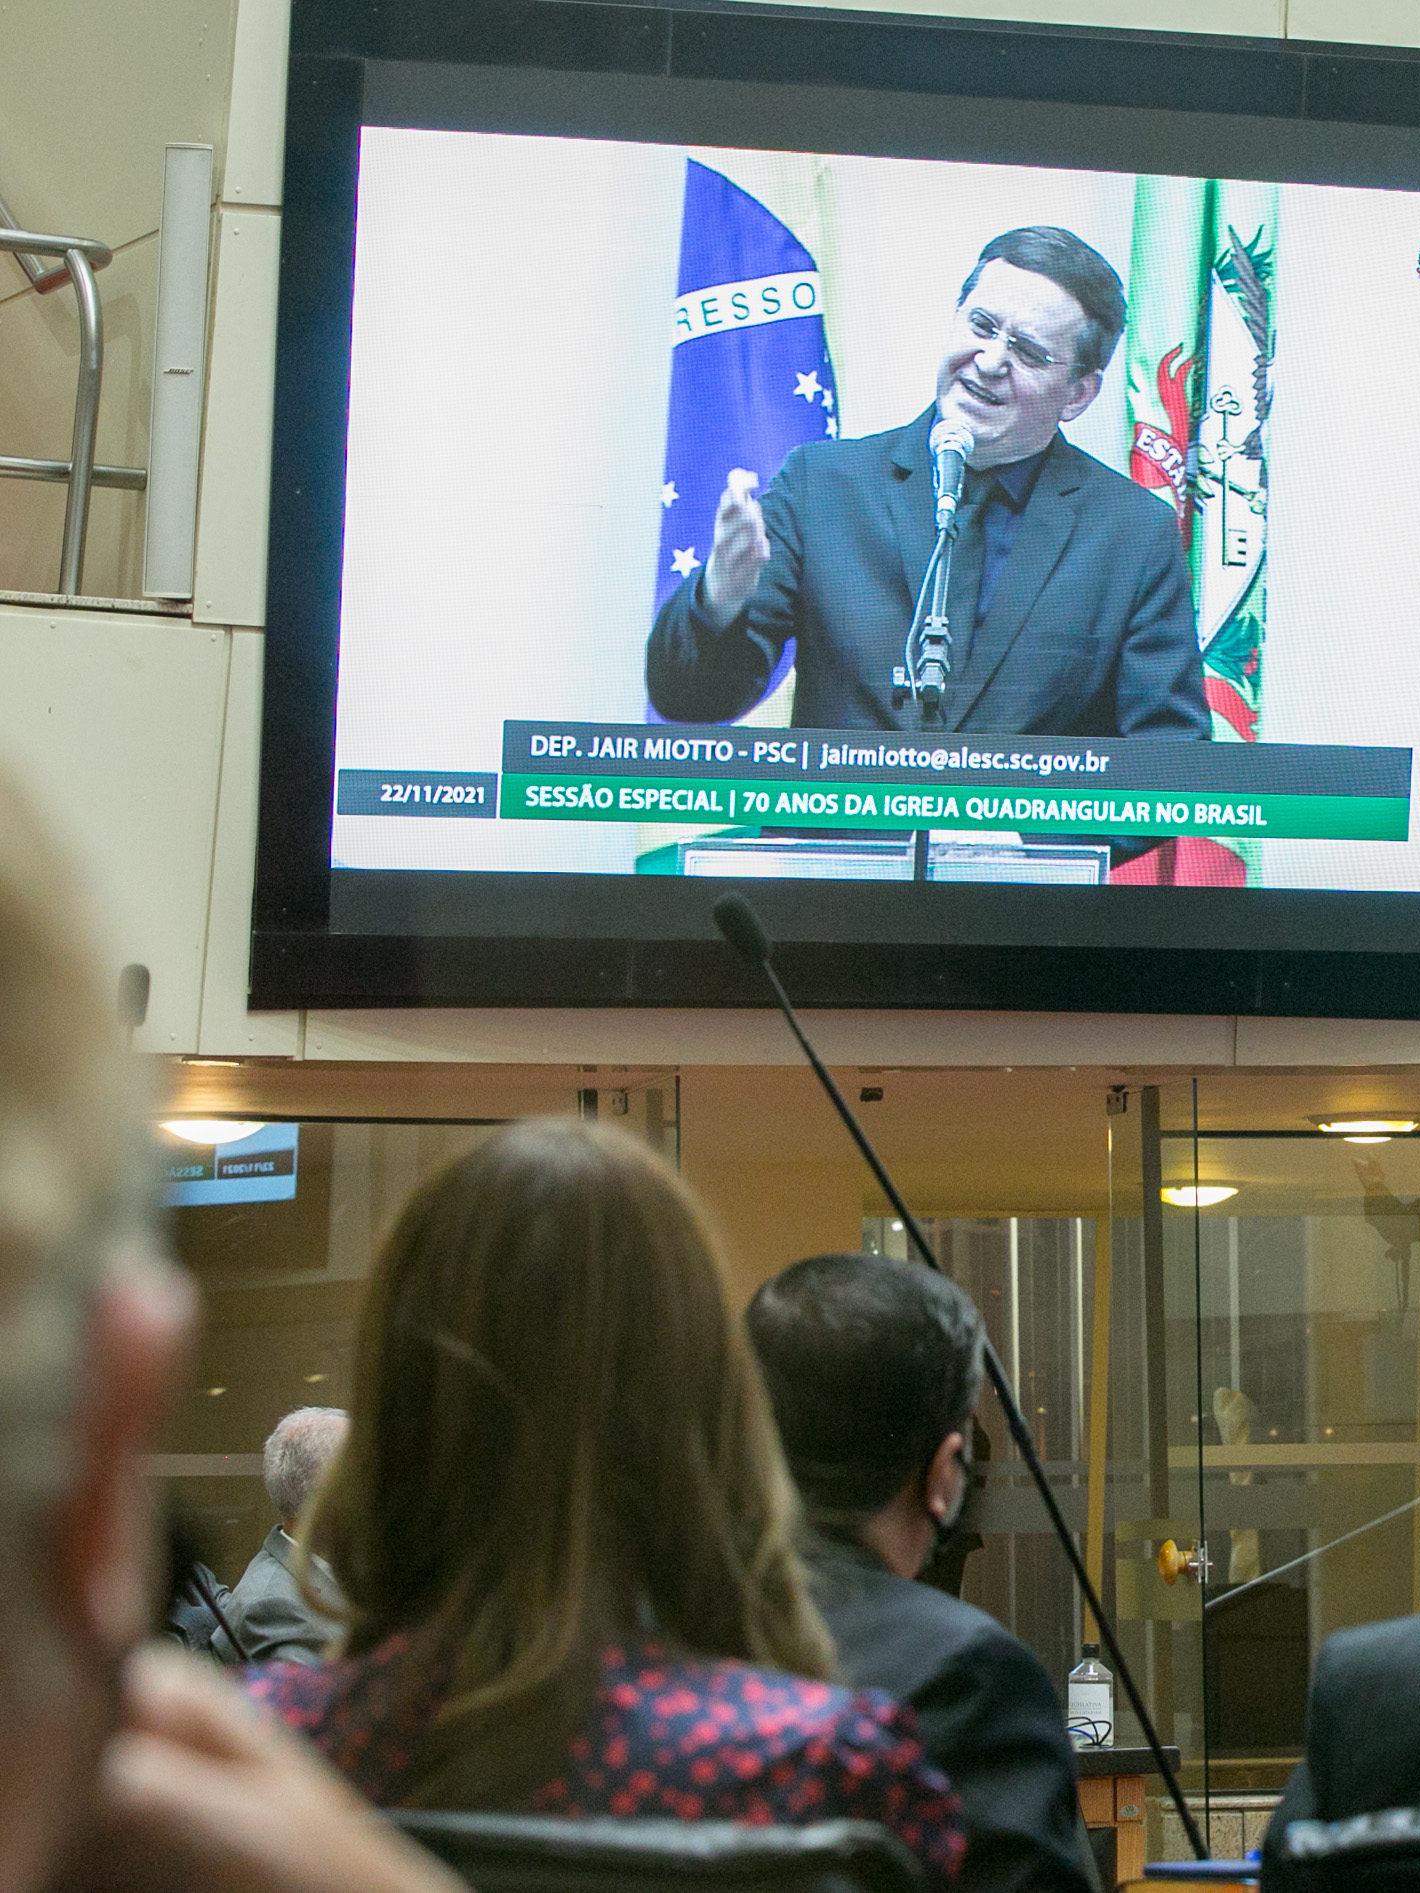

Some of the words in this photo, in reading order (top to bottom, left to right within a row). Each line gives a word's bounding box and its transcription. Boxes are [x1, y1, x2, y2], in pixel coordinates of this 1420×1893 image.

[676, 282, 816, 332] RESSO
[530, 734, 582, 757] DEP.
[587, 736, 638, 759] JAIR
[643, 737, 734, 762] MIOTTO
[753, 741, 797, 763] PSC
[819, 742, 1110, 775] jairmiotto@alesc.sc.gov.br
[380, 783, 485, 804] 22/11/2021
[525, 783, 614, 808] SESSÃO
[619, 787, 724, 812] ESPECIAL
[743, 791, 770, 813] 70
[774, 792, 839, 814] ANOS
[844, 793, 878, 815] DA
[883, 795, 960, 818] IGREJA
[965, 797, 1151, 823] QUADRANGULAR
[1155, 802, 1190, 824] NO
[1194, 803, 1268, 826] BRASIL
